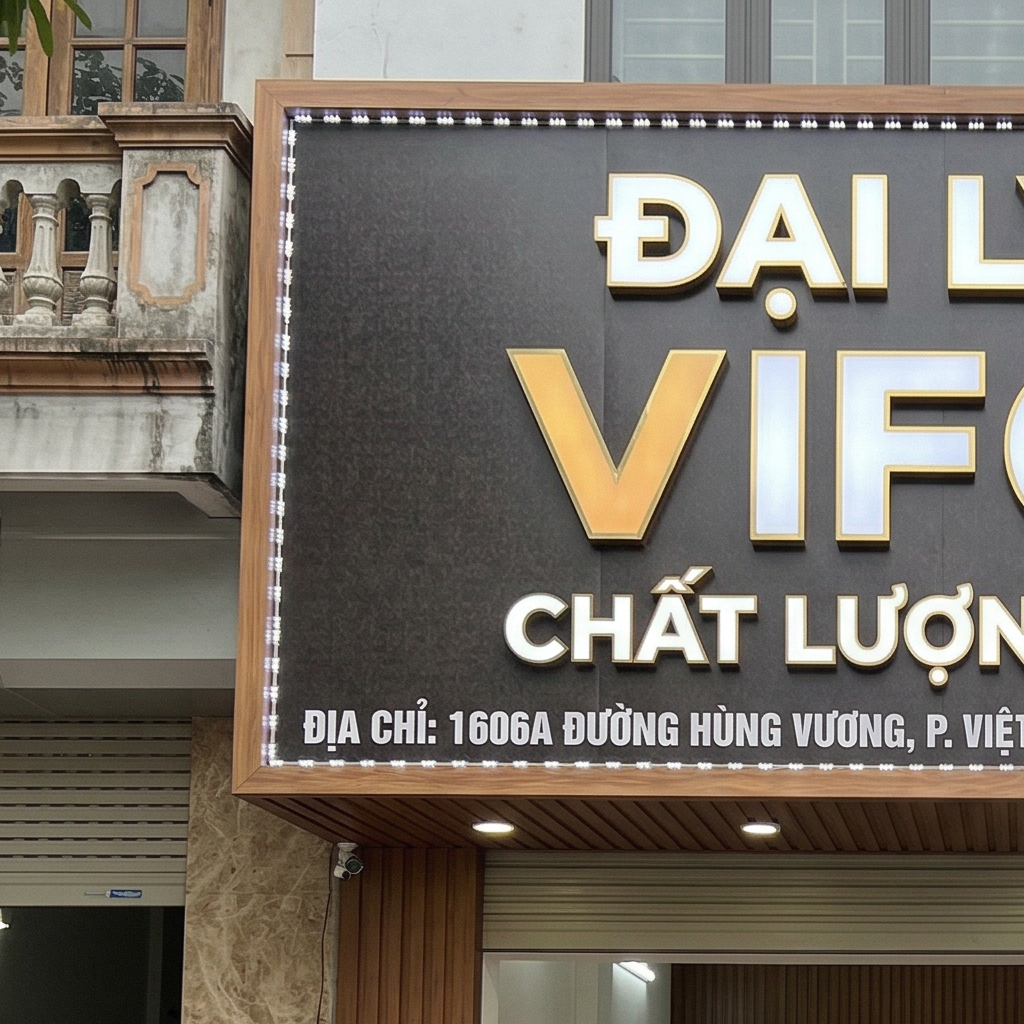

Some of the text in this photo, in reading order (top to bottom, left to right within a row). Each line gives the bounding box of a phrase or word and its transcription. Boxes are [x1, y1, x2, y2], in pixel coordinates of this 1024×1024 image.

[594, 173, 888, 327] ĐẠI
[503, 566, 758, 667] CHẤT
[303, 709, 361, 752] ĐỊA
[371, 697, 437, 745] CHỈ:
[449, 711, 553, 746] 1606A
[562, 702, 680, 747] ĐƯỜNG
[690, 704, 782, 748] HÙNG
[792, 709, 916, 754] VƯƠNG,
[926, 713, 954, 748] P.
